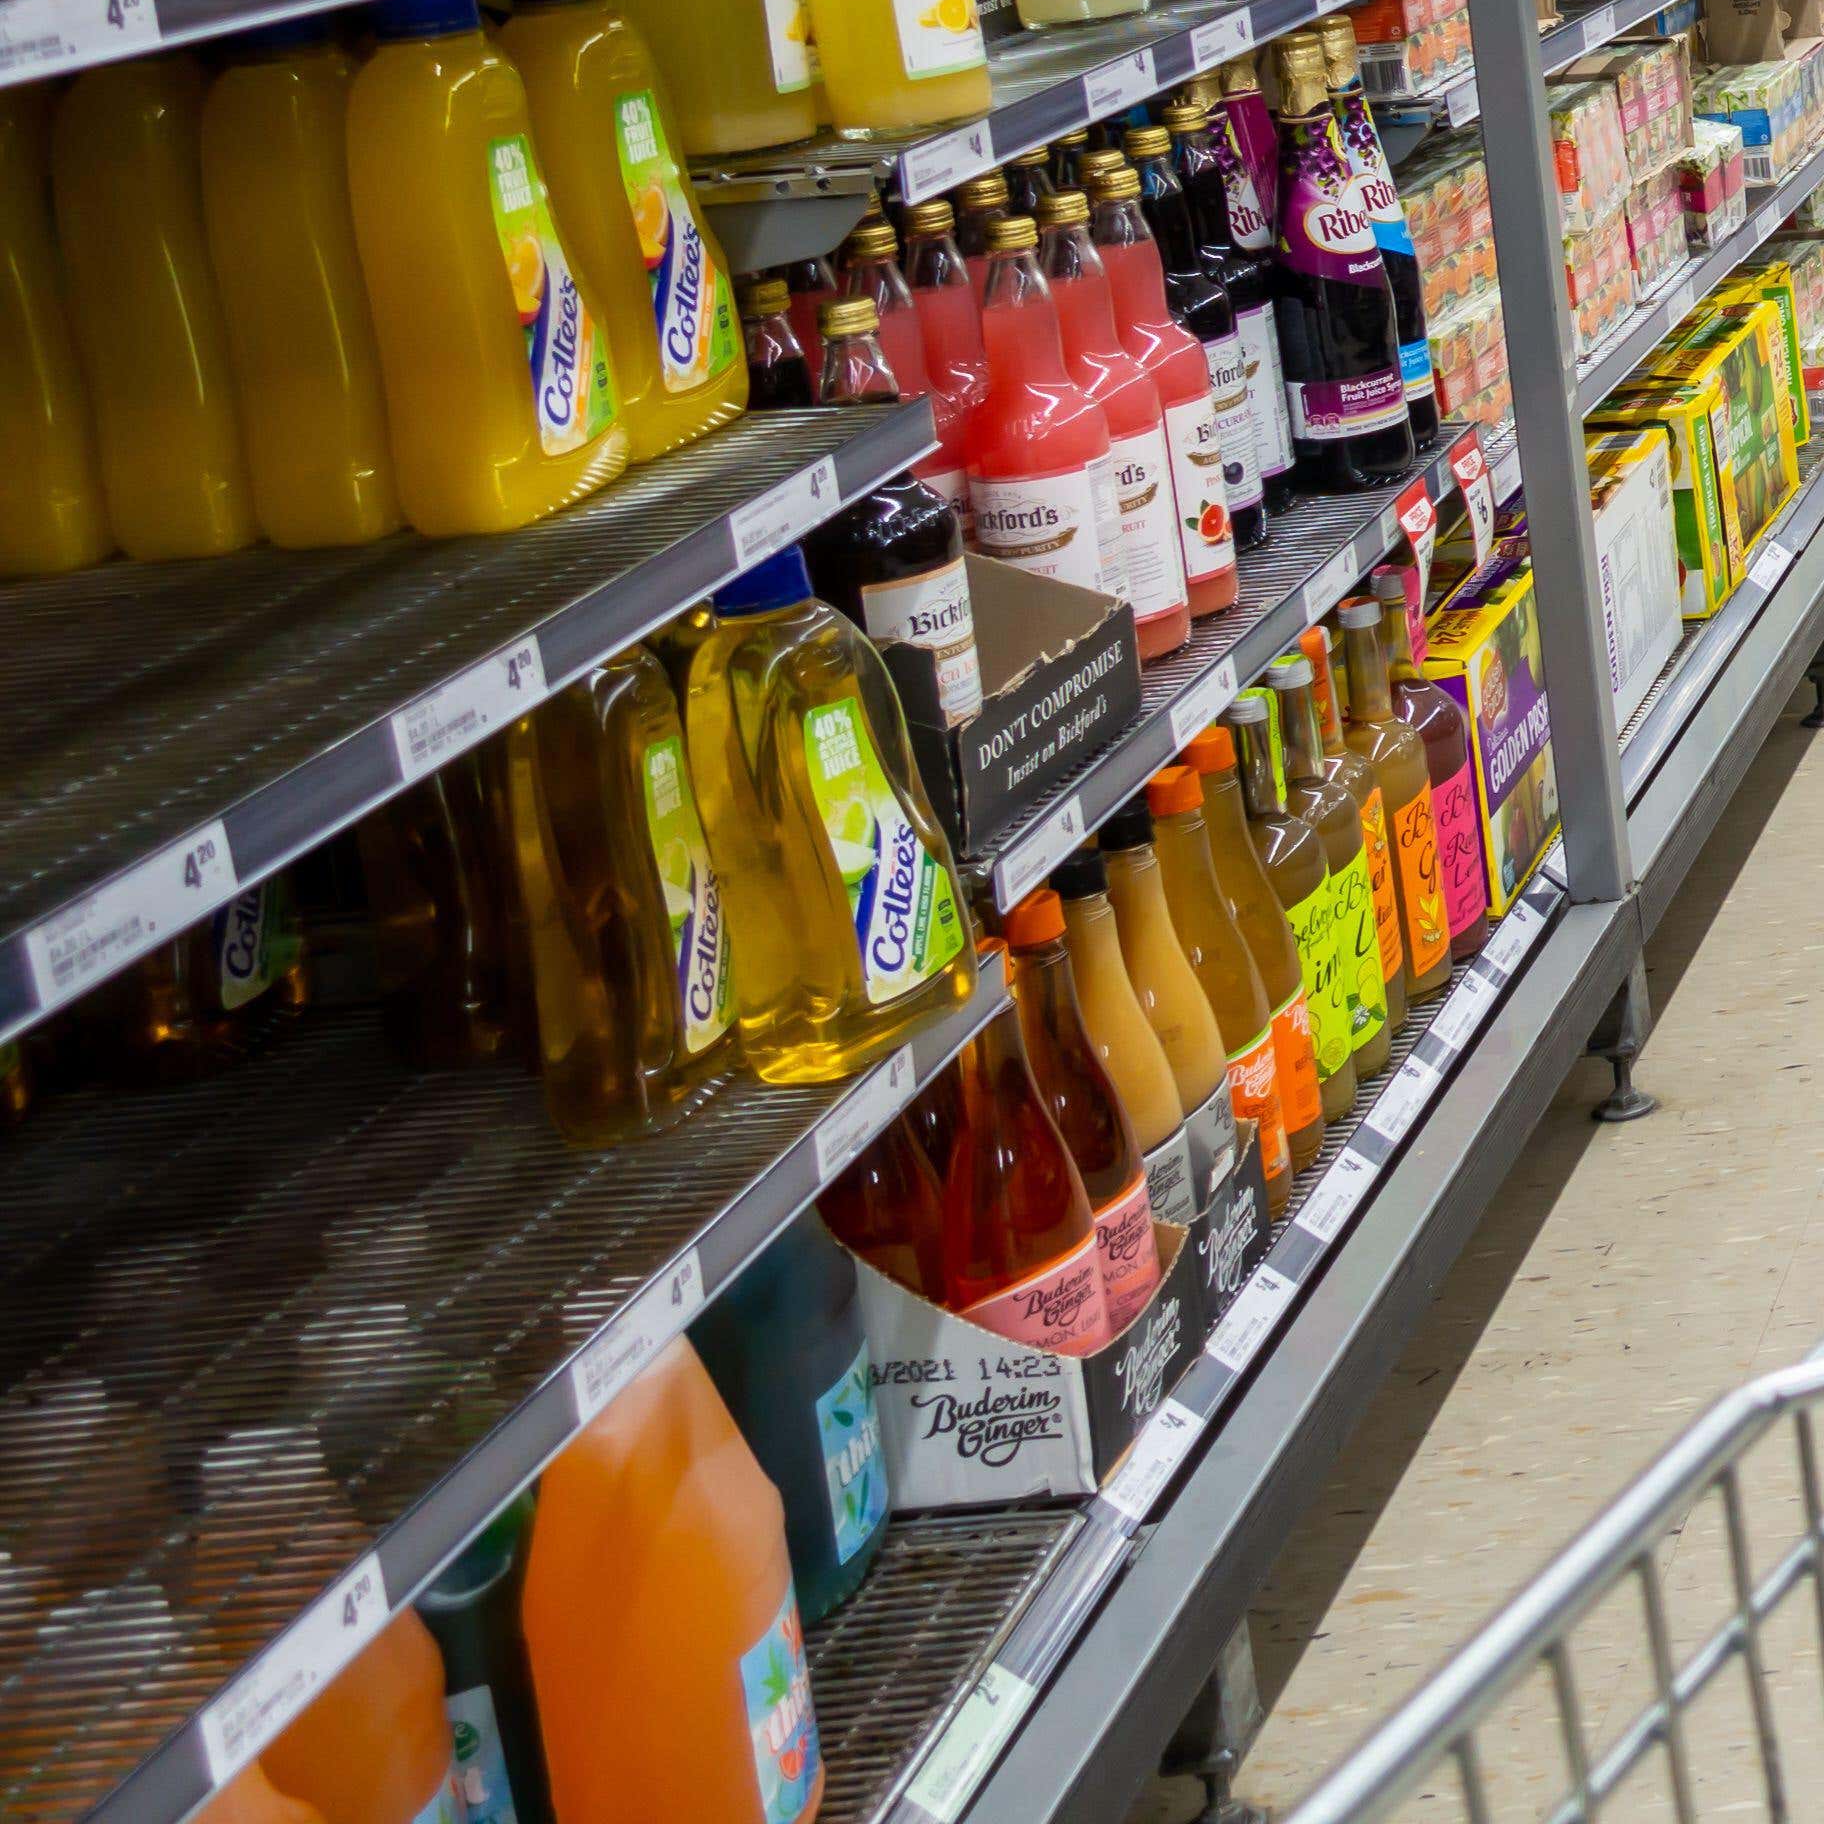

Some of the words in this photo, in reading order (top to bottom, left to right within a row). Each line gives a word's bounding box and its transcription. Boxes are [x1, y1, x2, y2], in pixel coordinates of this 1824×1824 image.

[1342, 388, 1366, 403] Fruit
[978, 714, 1028, 772] DON'T
[1030, 639, 1125, 730] COMPROMISE
[1006, 751, 1040, 790] Insist
[1041, 742, 1056, 765] on
[1057, 693, 1108, 754] Bickford's
[1490, 717, 1530, 794] GOLDEN
[872, 822, 918, 973] Cottee's
[1013, 1264, 1095, 1321] Buderim
[910, 1386, 1061, 1440] Buderim
[956, 1414, 1063, 1467] Ginger
